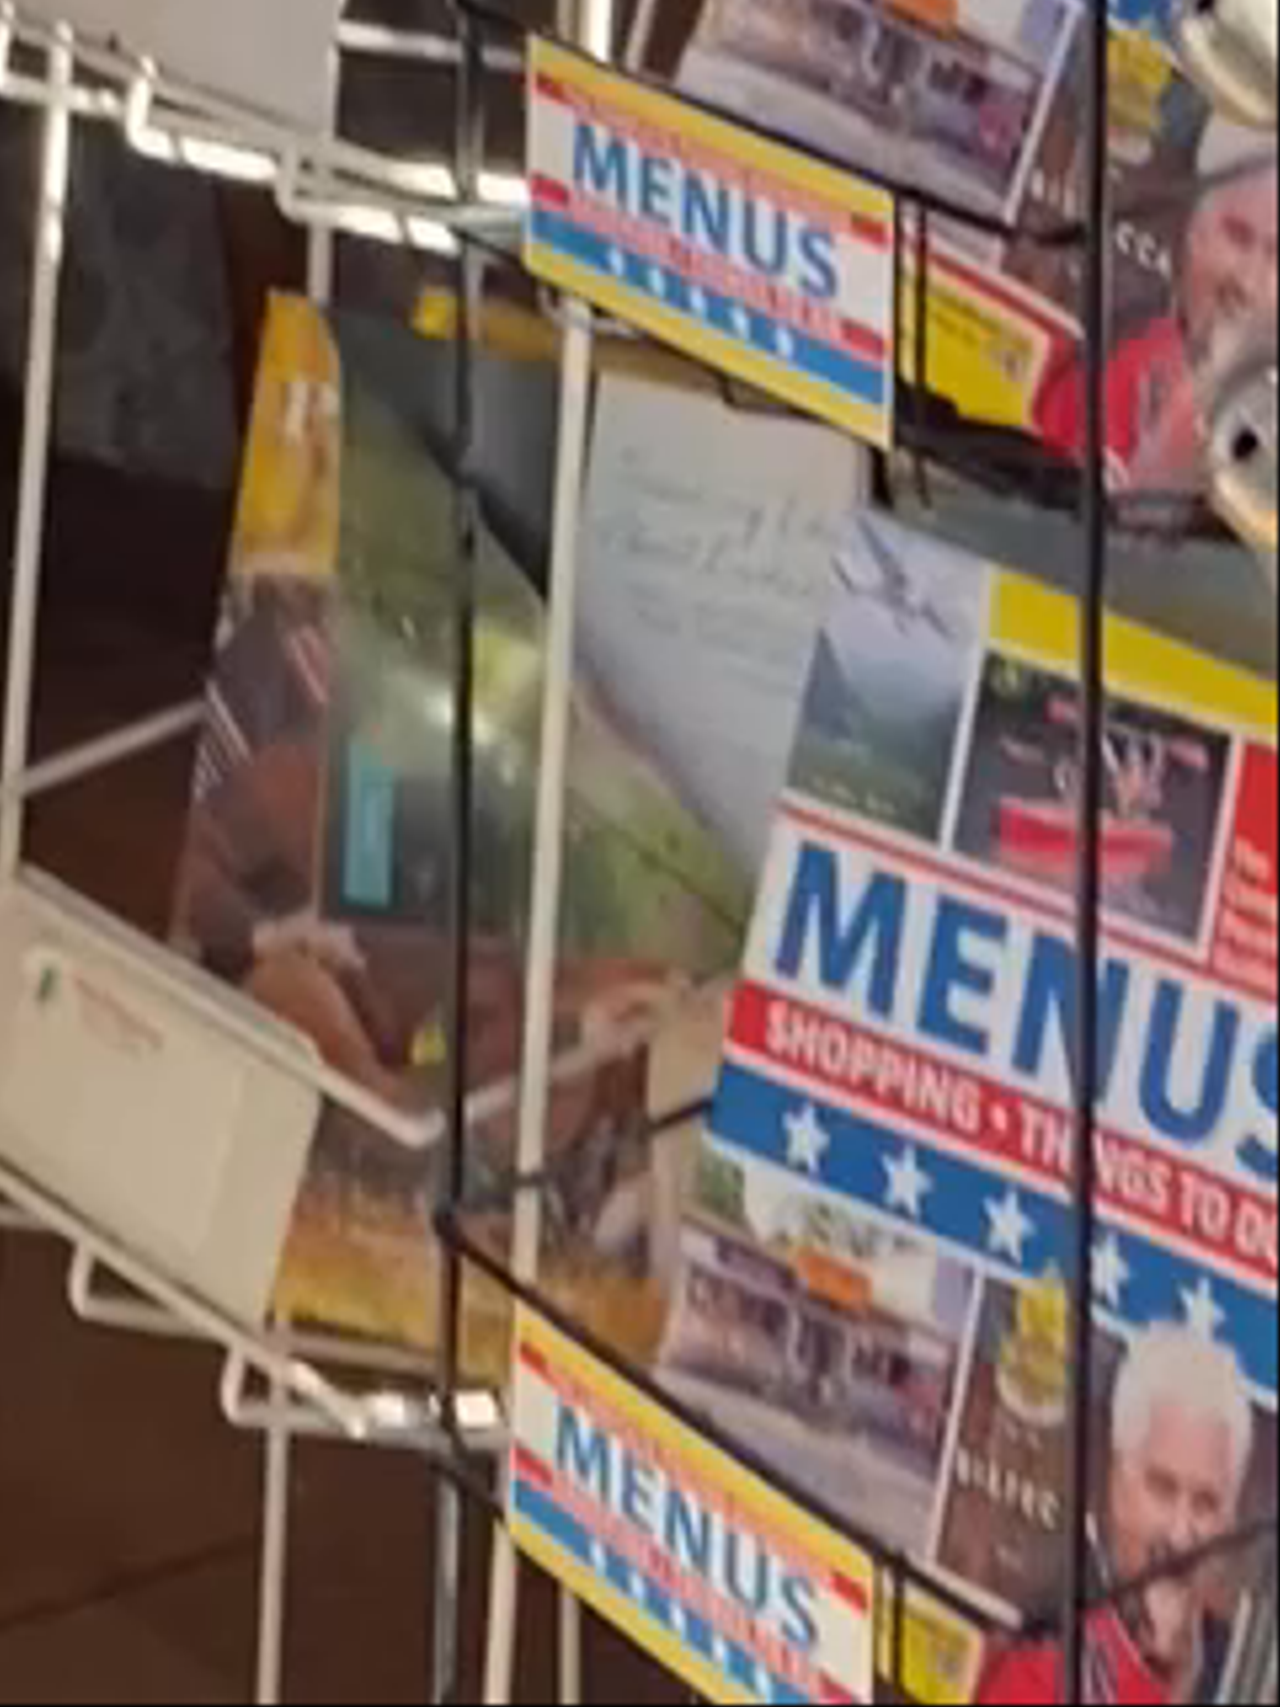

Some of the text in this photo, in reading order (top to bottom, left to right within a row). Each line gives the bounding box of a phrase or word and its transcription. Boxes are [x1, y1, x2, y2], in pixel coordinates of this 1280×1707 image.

[572, 123, 841, 300] MENUS
[765, 998, 982, 1132] SHOPPING
[1019, 1104, 1172, 1213] THNGS
[1181, 1169, 1232, 1237] TO
[553, 1403, 821, 1655] MENUS
